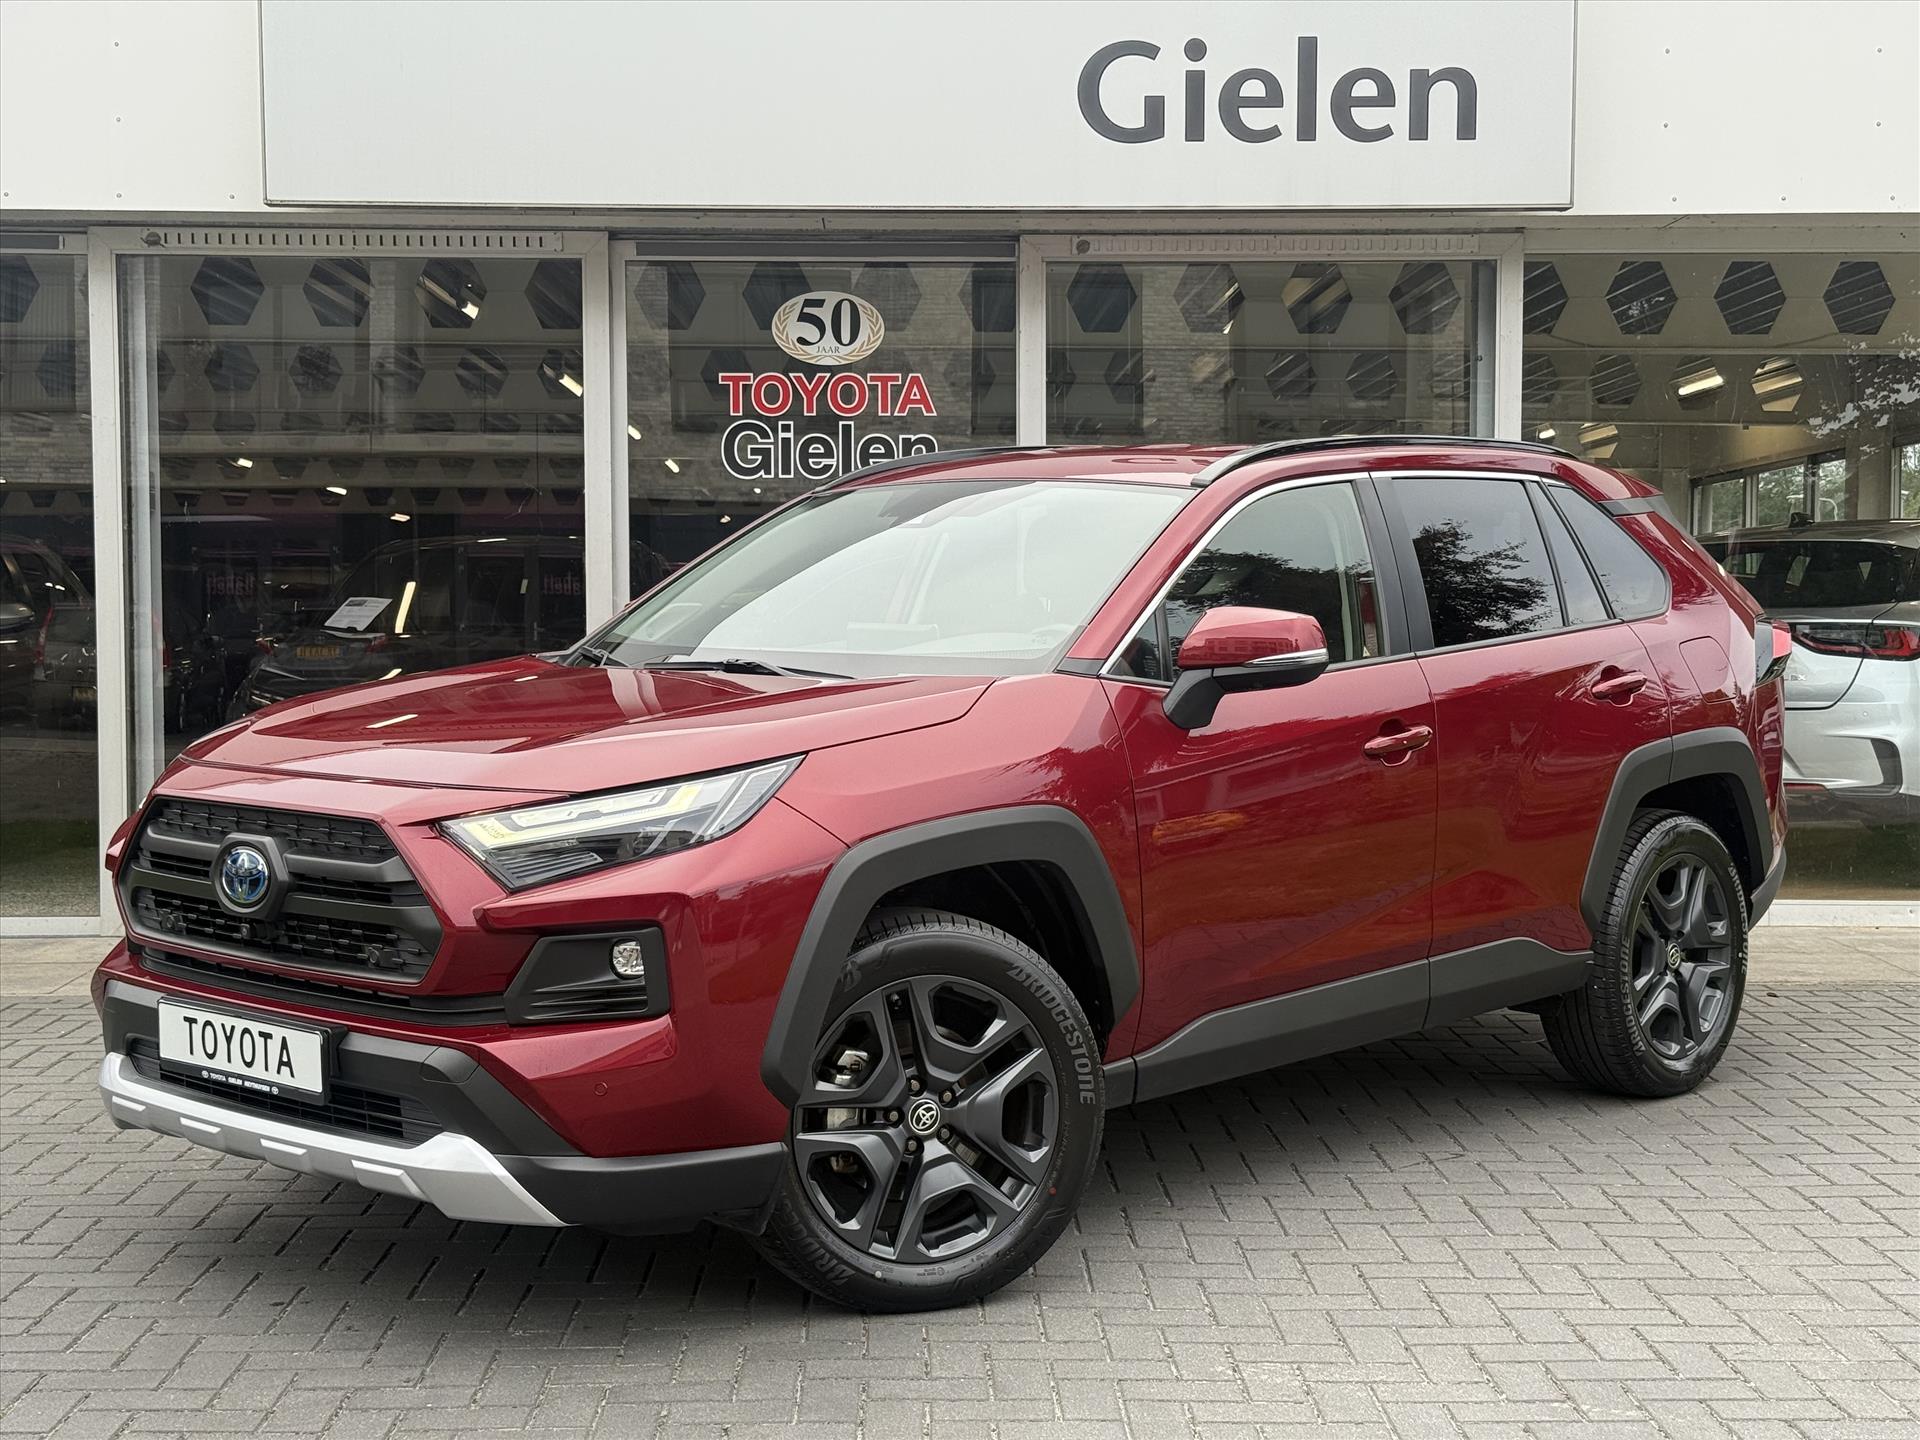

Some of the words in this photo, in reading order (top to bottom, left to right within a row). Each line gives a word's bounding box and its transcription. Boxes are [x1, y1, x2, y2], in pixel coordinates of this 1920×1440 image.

[1077, 36, 1478, 144] Gielen
[796, 298, 861, 347] 50
[816, 345, 841, 355] JAAR
[718, 372, 937, 416] TOYOTA
[183, 1016, 295, 1078] TOYOTA
[1006, 962, 1096, 1105] BRIDGESTONE
